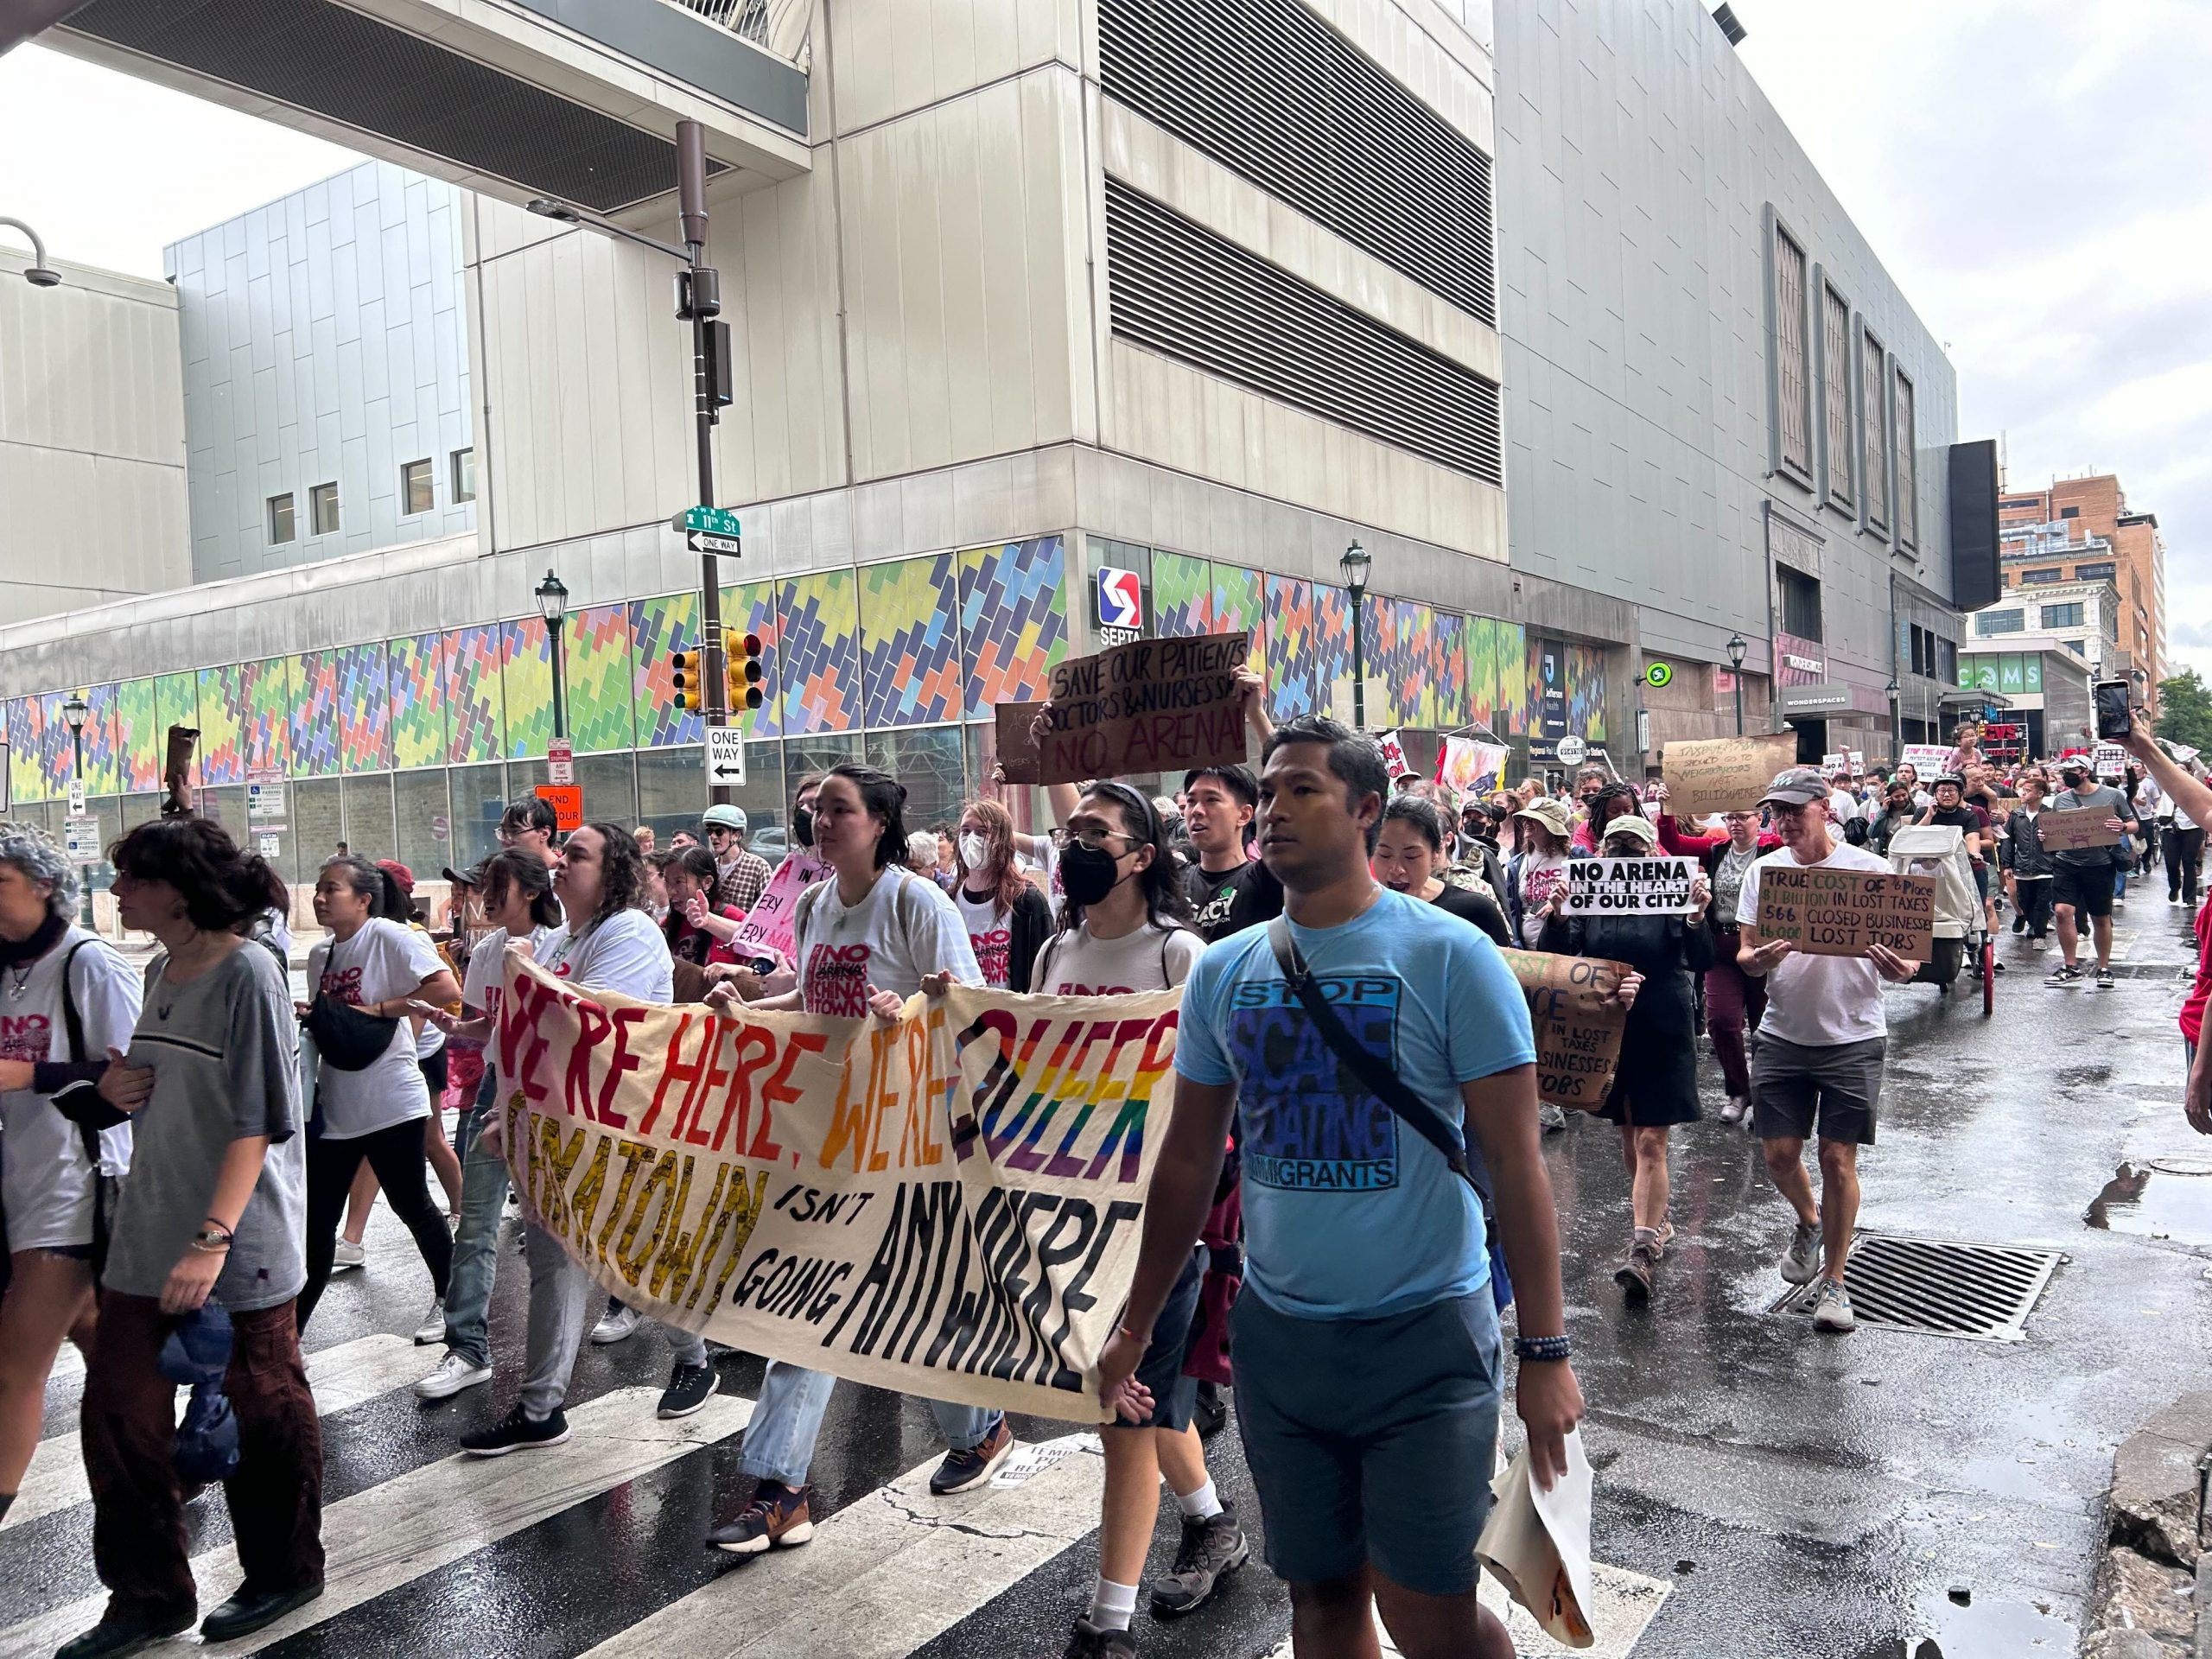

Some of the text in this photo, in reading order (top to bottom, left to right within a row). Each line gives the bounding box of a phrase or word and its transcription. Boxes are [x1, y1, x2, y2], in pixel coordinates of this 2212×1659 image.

[702, 515, 736, 533] 11th St
[703, 538, 735, 550] ONE WAY
[1100, 626, 1141, 646] SEPTA
[1054, 638, 1248, 701] SAVE OUR PATIENTS
[1787, 696, 1846, 706] WONDERSPACES
[712, 732, 739, 745] ONE
[1054, 704, 1247, 775] NO ARENA!
[1984, 725, 2018, 741] CVS
[712, 747, 739, 760] WAY
[549, 795, 569, 804] END
[557, 811, 579, 821] OUR
[797, 868, 814, 883] IN
[1569, 861, 1689, 881] NO ARENA
[1569, 881, 1589, 894] IN
[1592, 881, 1626, 893] THE
[1630, 880, 1689, 893] HEART
[1764, 870, 1810, 888] TRUE
[1814, 874, 1861, 891] COST
[1864, 878, 1886, 893] OF
[1902, 879, 1935, 897] Place
[756, 893, 785, 915] ERY
[1569, 893, 1689, 909] OF OUR CITY
[1783, 890, 1829, 906] BILLION
[1833, 891, 1849, 906] IN
[1852, 893, 1885, 909] LOST
[1890, 895, 1930, 912] TAXES
[1764, 906, 1935, 931] 566 CLOSED BUSINESSES
[739, 923, 768, 944] ERY
[969, 929, 1011, 947] NO
[1810, 926, 1861, 945] LOST
[1866, 931, 1917, 951] JOBS
[820, 944, 871, 963] NO
[977, 957, 1011, 970] HINA
[982, 969, 1011, 983] OWN
[1569, 962, 1612, 988] OF
[814, 978, 866, 1001] CHINA
[1234, 980, 1395, 1007] STOP
[814, 998, 868, 1019] TOWN
[1551, 1023, 1611, 1044] IN LOST
[1562, 1037, 1599, 1053] TAXES
[1537, 1049, 1612, 1075] SINESSES
[818, 1007, 949, 1173] WE'RE
[944, 1008, 1182, 1184] QUEER
[773, 1183, 874, 1224] ISN'T
[731, 1247, 855, 1325] GOING
[820, 1179, 1144, 1395] ANYWHERE
